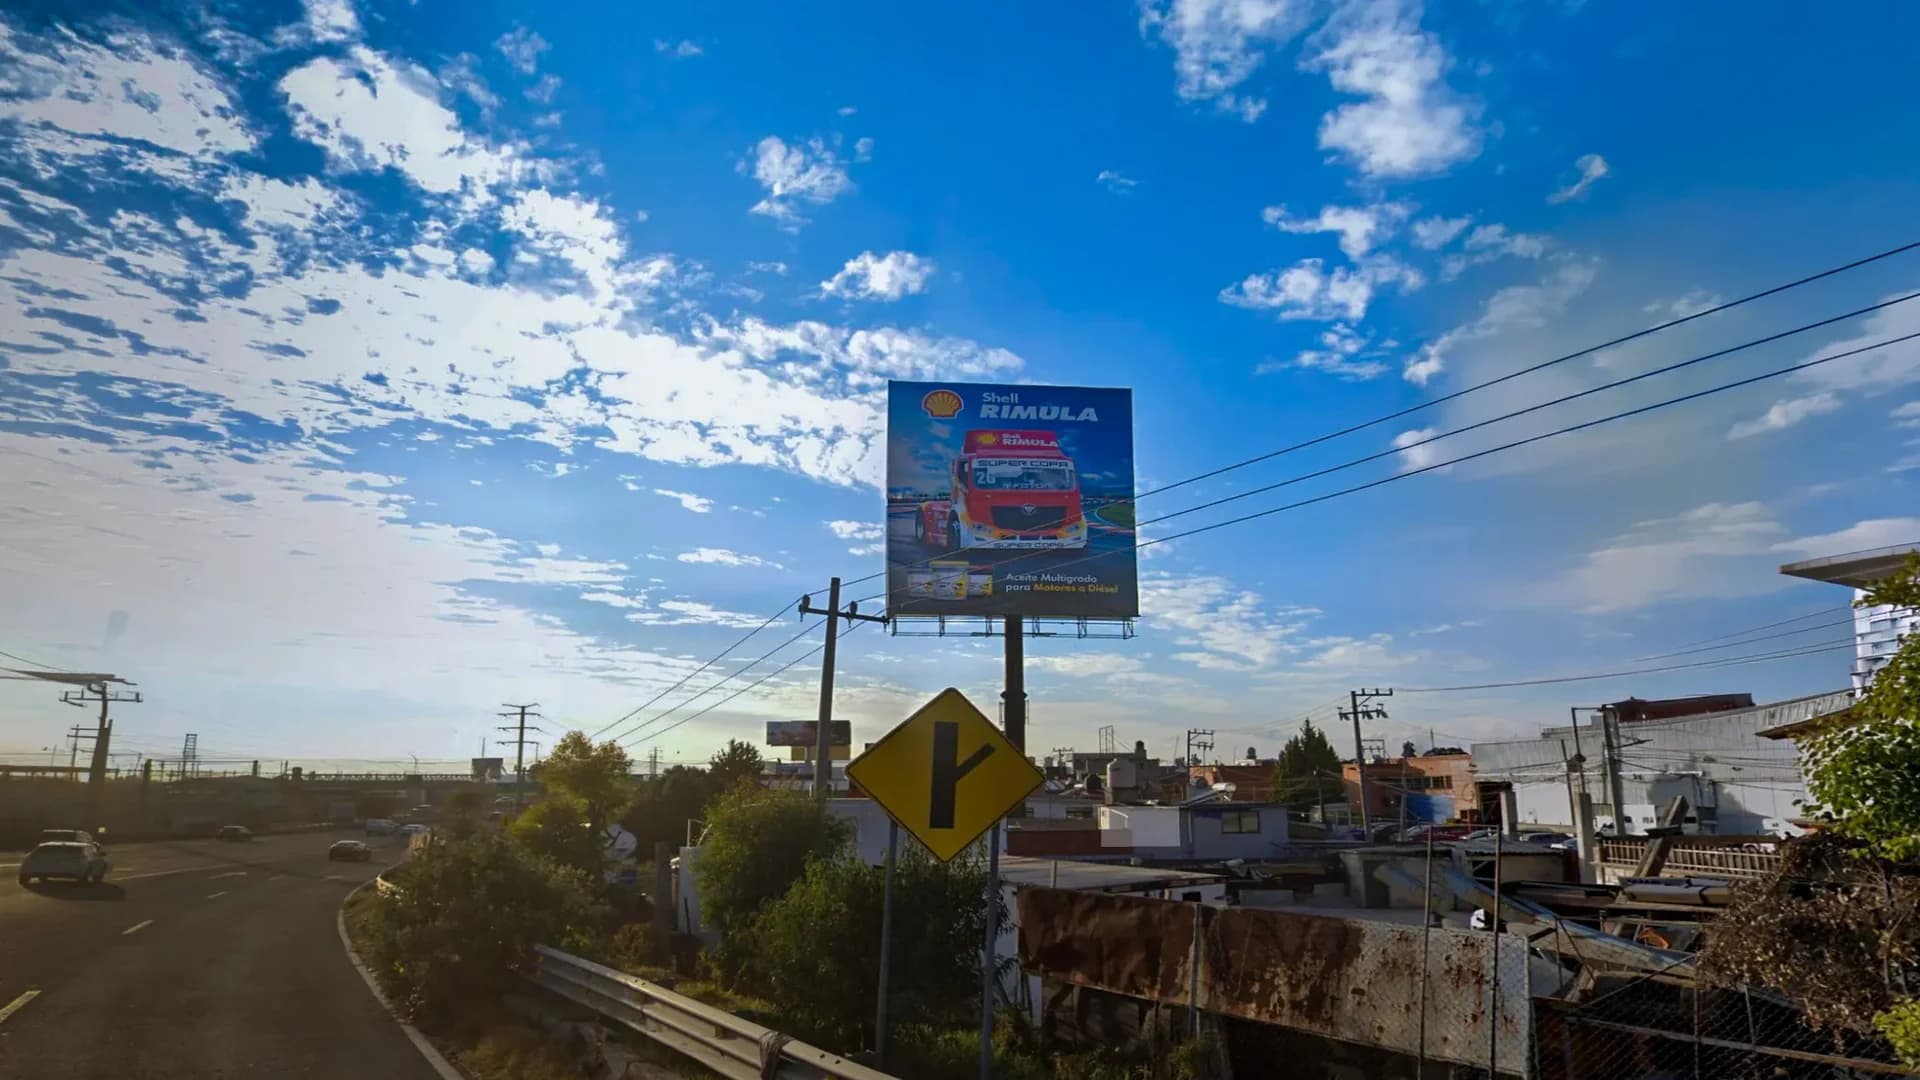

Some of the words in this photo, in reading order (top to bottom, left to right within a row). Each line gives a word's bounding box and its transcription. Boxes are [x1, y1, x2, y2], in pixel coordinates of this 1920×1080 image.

[982, 392, 1018, 403] Shell
[979, 404, 1098, 421] RIMULA
[1002, 438, 1059, 447] RIMULA
[977, 459, 1026, 467] SUPER
[1030, 460, 1069, 468] COPA
[1006, 573, 1038, 581] Aceite
[1041, 573, 1098, 584] Multigrado
[1006, 584, 1030, 592] para
[1033, 583, 1076, 592] Motores
